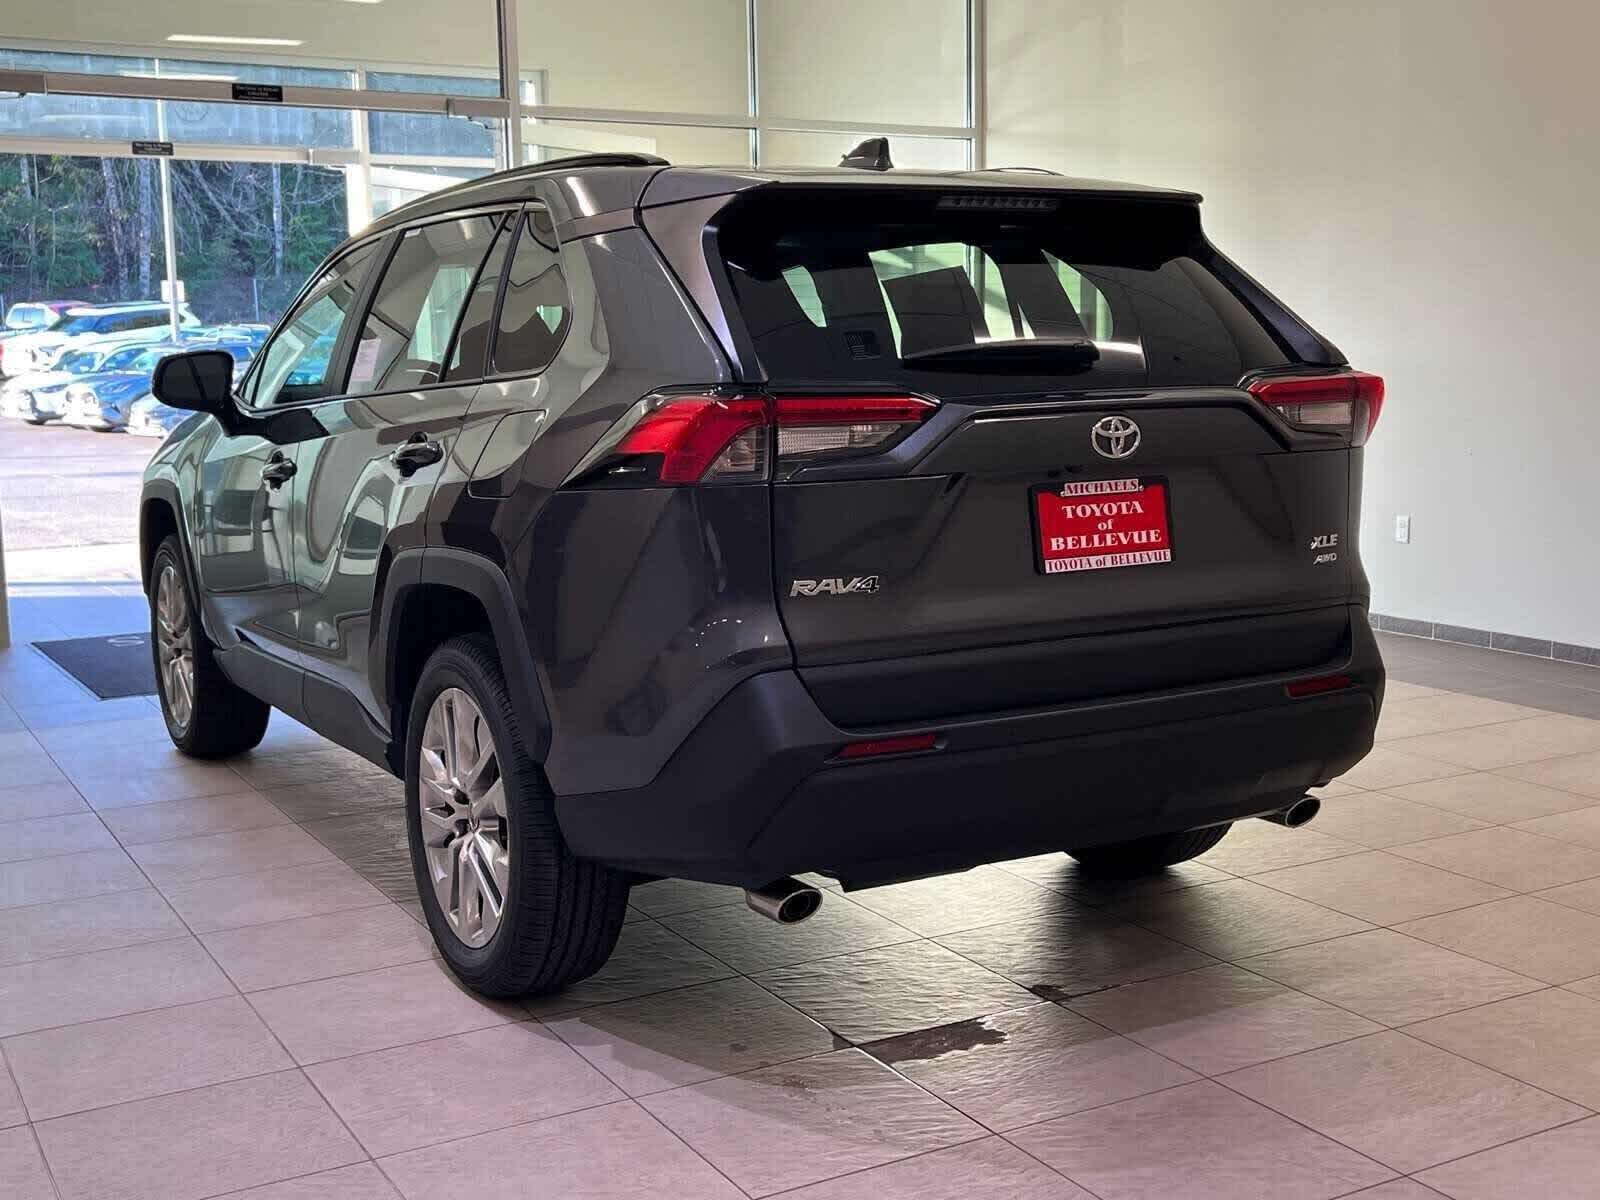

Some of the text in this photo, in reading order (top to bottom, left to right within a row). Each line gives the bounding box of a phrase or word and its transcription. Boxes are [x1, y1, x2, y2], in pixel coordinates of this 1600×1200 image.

[1066, 480, 1138, 495] MICHAELS
[1062, 501, 1144, 519] TOYOTA
[1098, 519, 1113, 530] of
[1050, 529, 1162, 550] BELLEVUE
[1310, 534, 1339, 549] XLE
[1047, 550, 1170, 572] TOYOTA of BELLEVUE
[1313, 552, 1337, 565] AWD
[790, 575, 880, 597] RAV4
